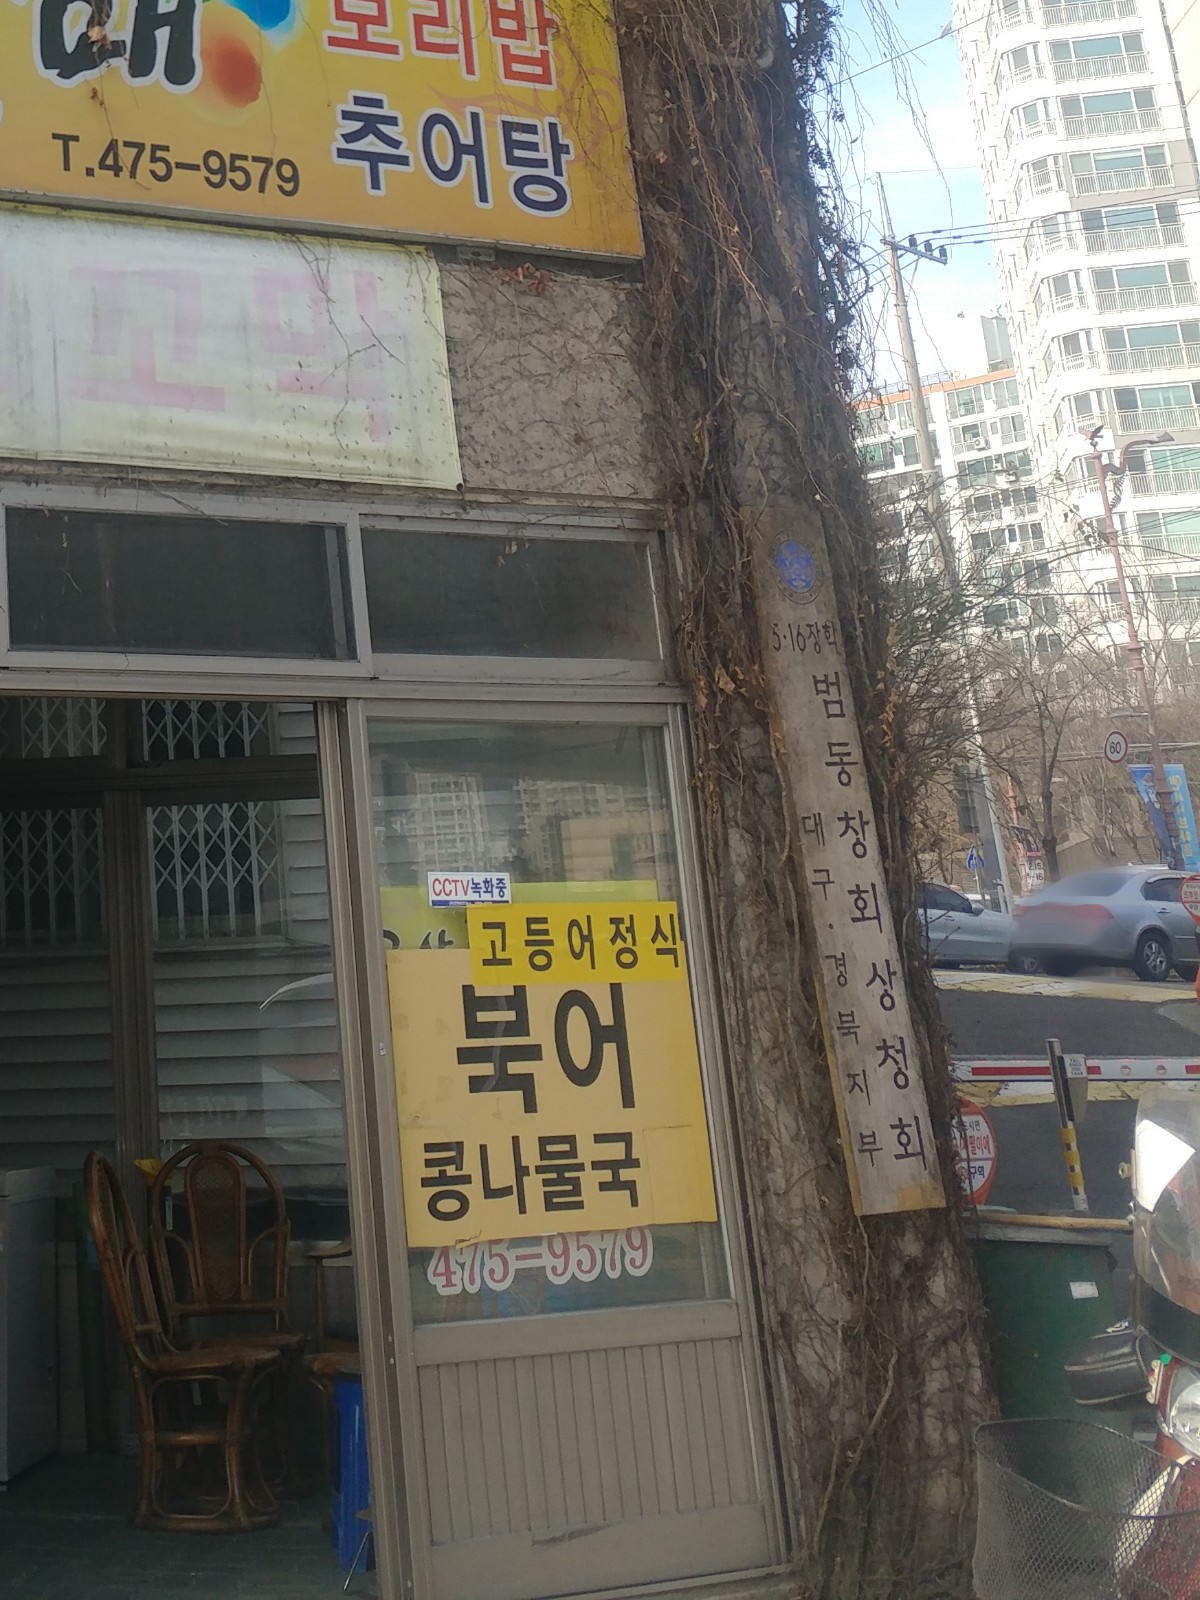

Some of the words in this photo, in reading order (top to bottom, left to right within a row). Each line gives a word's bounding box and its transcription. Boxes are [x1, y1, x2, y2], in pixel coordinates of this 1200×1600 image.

[52, 133, 301, 198] T.475-9579
[335, 93, 572, 216] 추어탕
[1109, 741, 1122, 755] 60
[482, 913, 680, 972] 고등어정식
[456, 982, 636, 1114] 북어
[421, 1131, 641, 1221] 콩나물국
[430, 1228, 652, 1293] 475-9579
